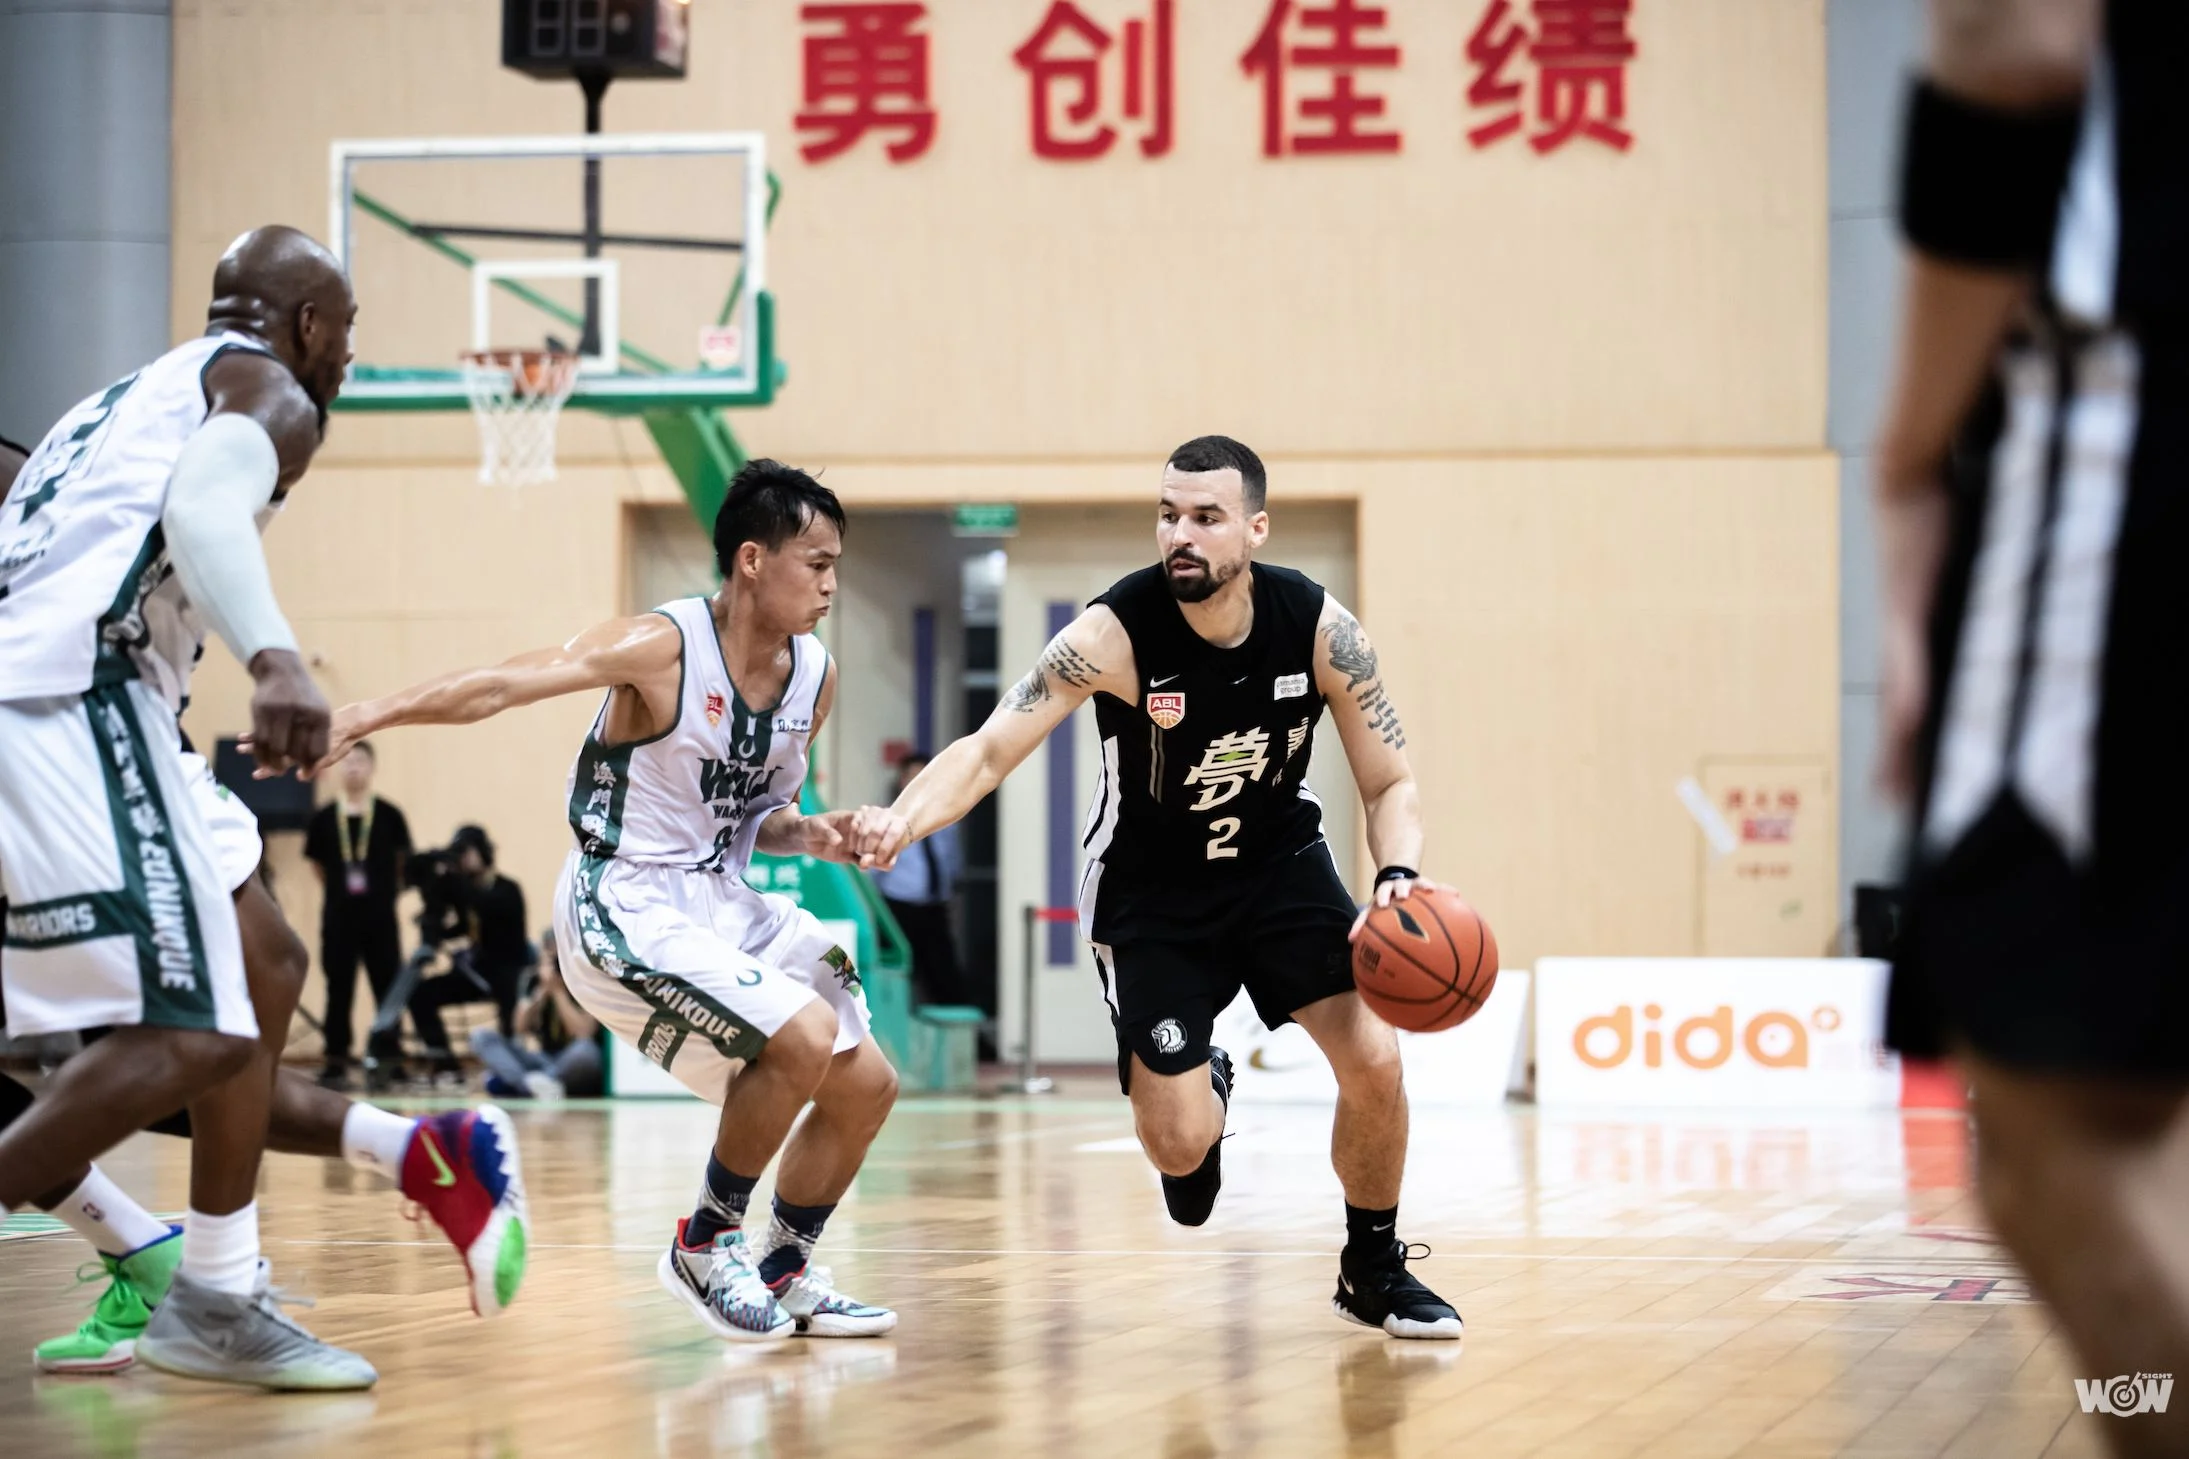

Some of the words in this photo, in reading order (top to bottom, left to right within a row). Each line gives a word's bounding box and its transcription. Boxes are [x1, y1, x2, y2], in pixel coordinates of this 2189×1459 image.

[794, 0, 1637, 164] 勇创佳绩
[1152, 698, 1181, 710] ABL
[1206, 816, 1241, 861] 2
[1574, 1003, 1808, 1068] dida
